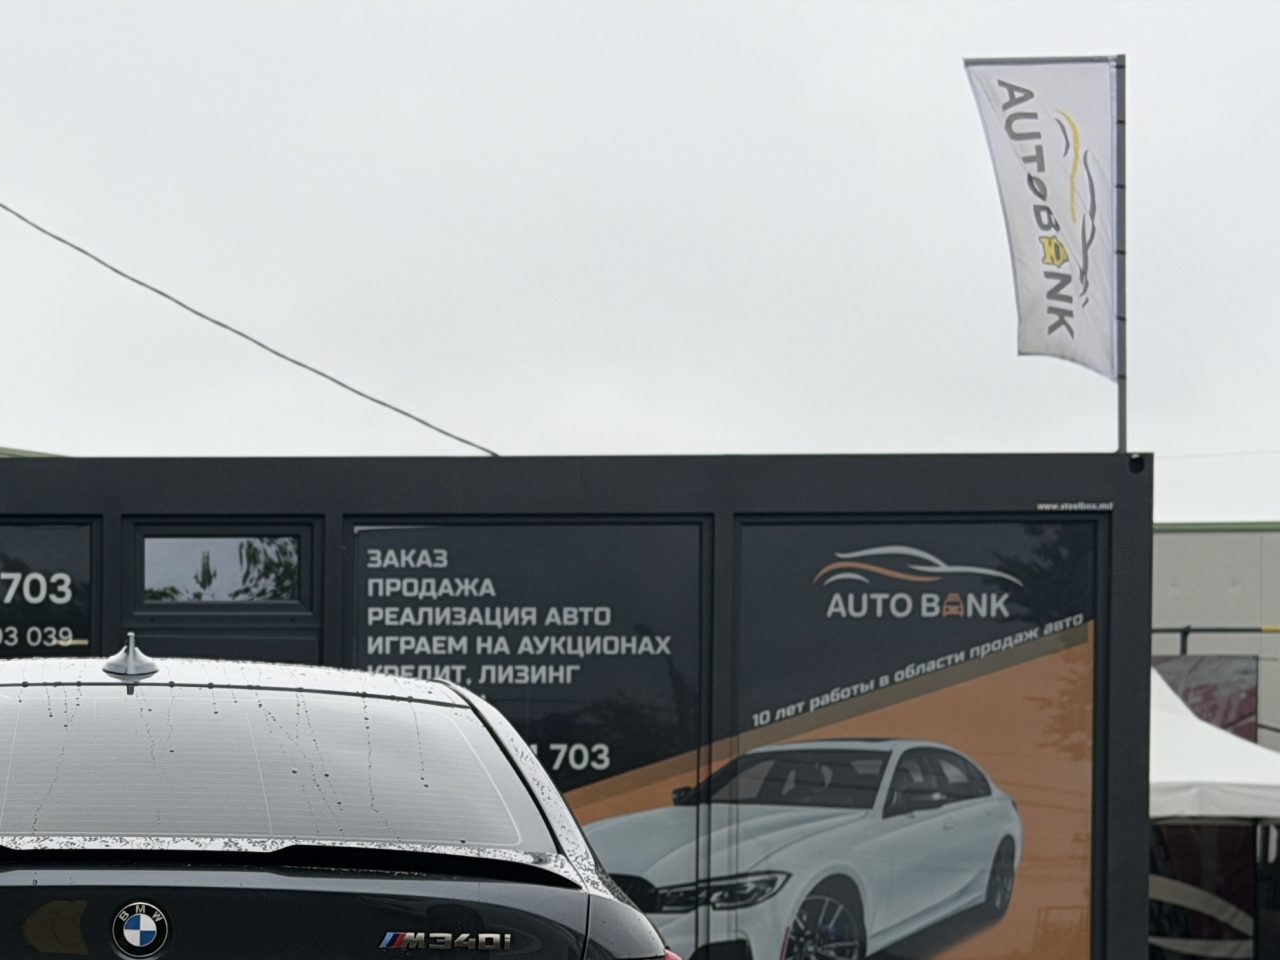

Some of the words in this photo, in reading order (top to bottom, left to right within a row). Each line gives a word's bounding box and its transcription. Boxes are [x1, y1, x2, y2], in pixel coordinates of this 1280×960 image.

[367, 549, 448, 568] ЗАКАЗ
[0, 572, 72, 604] 703
[368, 578, 496, 599] ПРОДАЖА
[826, 593, 913, 618] AUTO
[368, 607, 537, 628] РЕАЛИЗАЦИЯ
[545, 607, 612, 626] АВТО
[26, 627, 73, 647] 039
[368, 636, 468, 655] ИГРАЕМ
[476, 636, 510, 655] НА
[518, 636, 672, 657] АУКЦИОНАХ
[478, 665, 580, 684] ЛИЗИНГ
[752, 711, 772, 728] 10
[774, 702, 806, 722] лет
[808, 680, 875, 713] работы
[878, 675, 891, 688] в
[894, 651, 966, 682] области
[969, 630, 1039, 660] продаж
[1043, 614, 1084, 636] авто
[549, 744, 610, 770] 703
[118, 904, 163, 922] BMW
